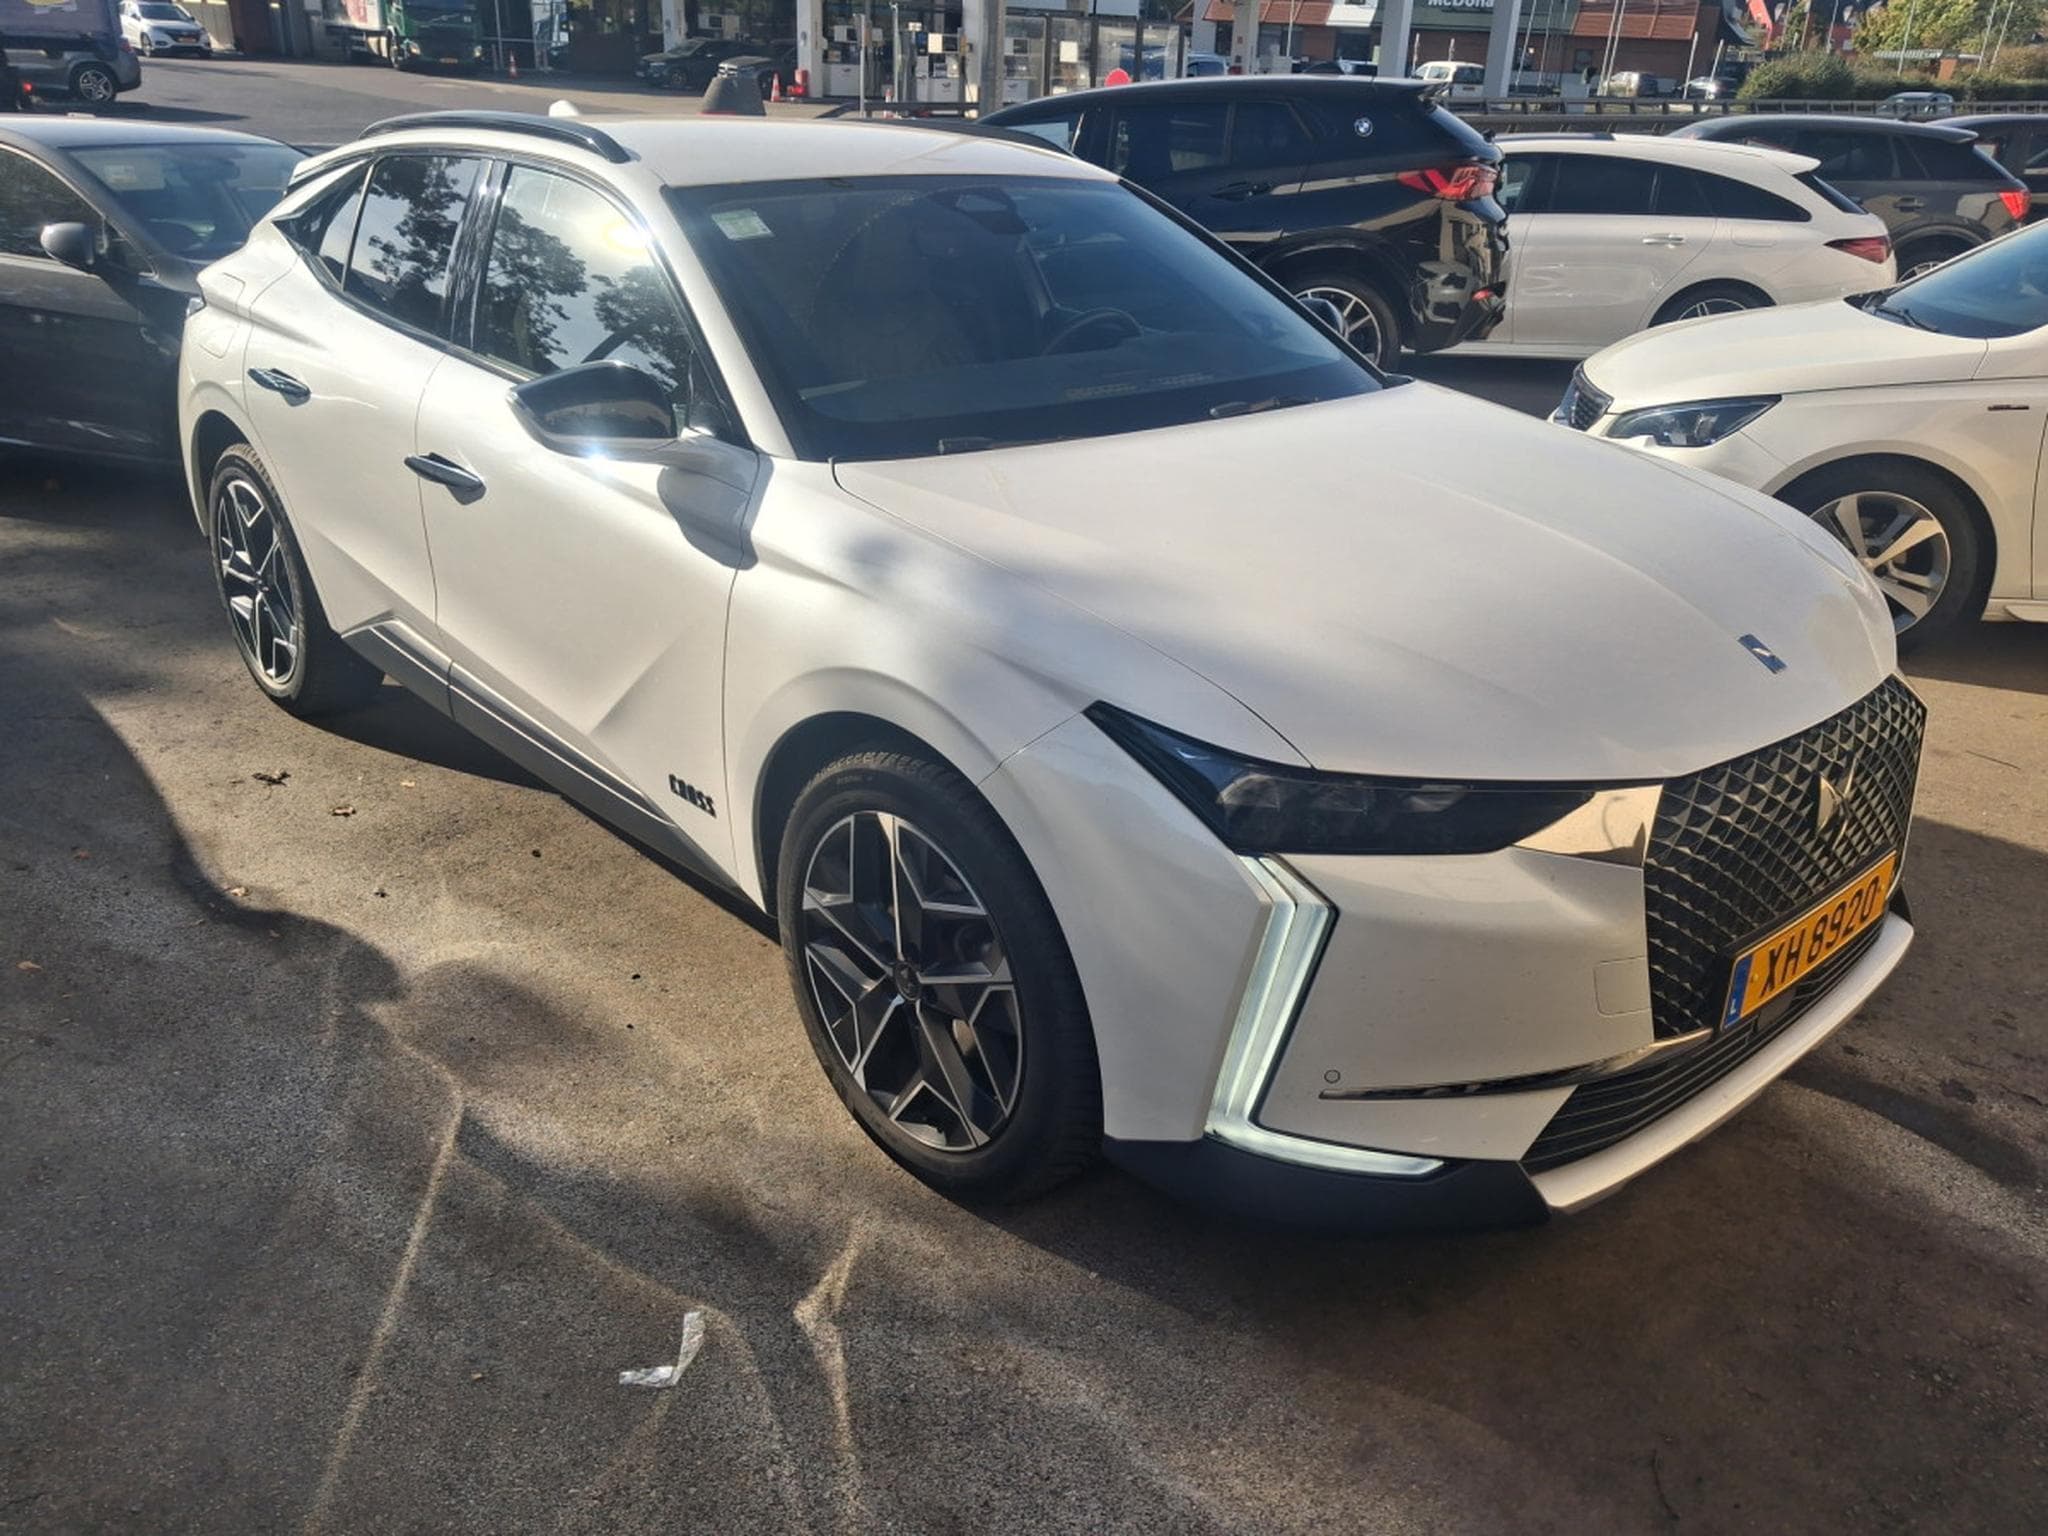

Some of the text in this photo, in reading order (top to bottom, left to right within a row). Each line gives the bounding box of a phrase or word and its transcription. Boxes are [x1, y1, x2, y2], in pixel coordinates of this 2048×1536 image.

[669, 773, 717, 818] CROSS
[1760, 875, 1880, 998] XH 8920
